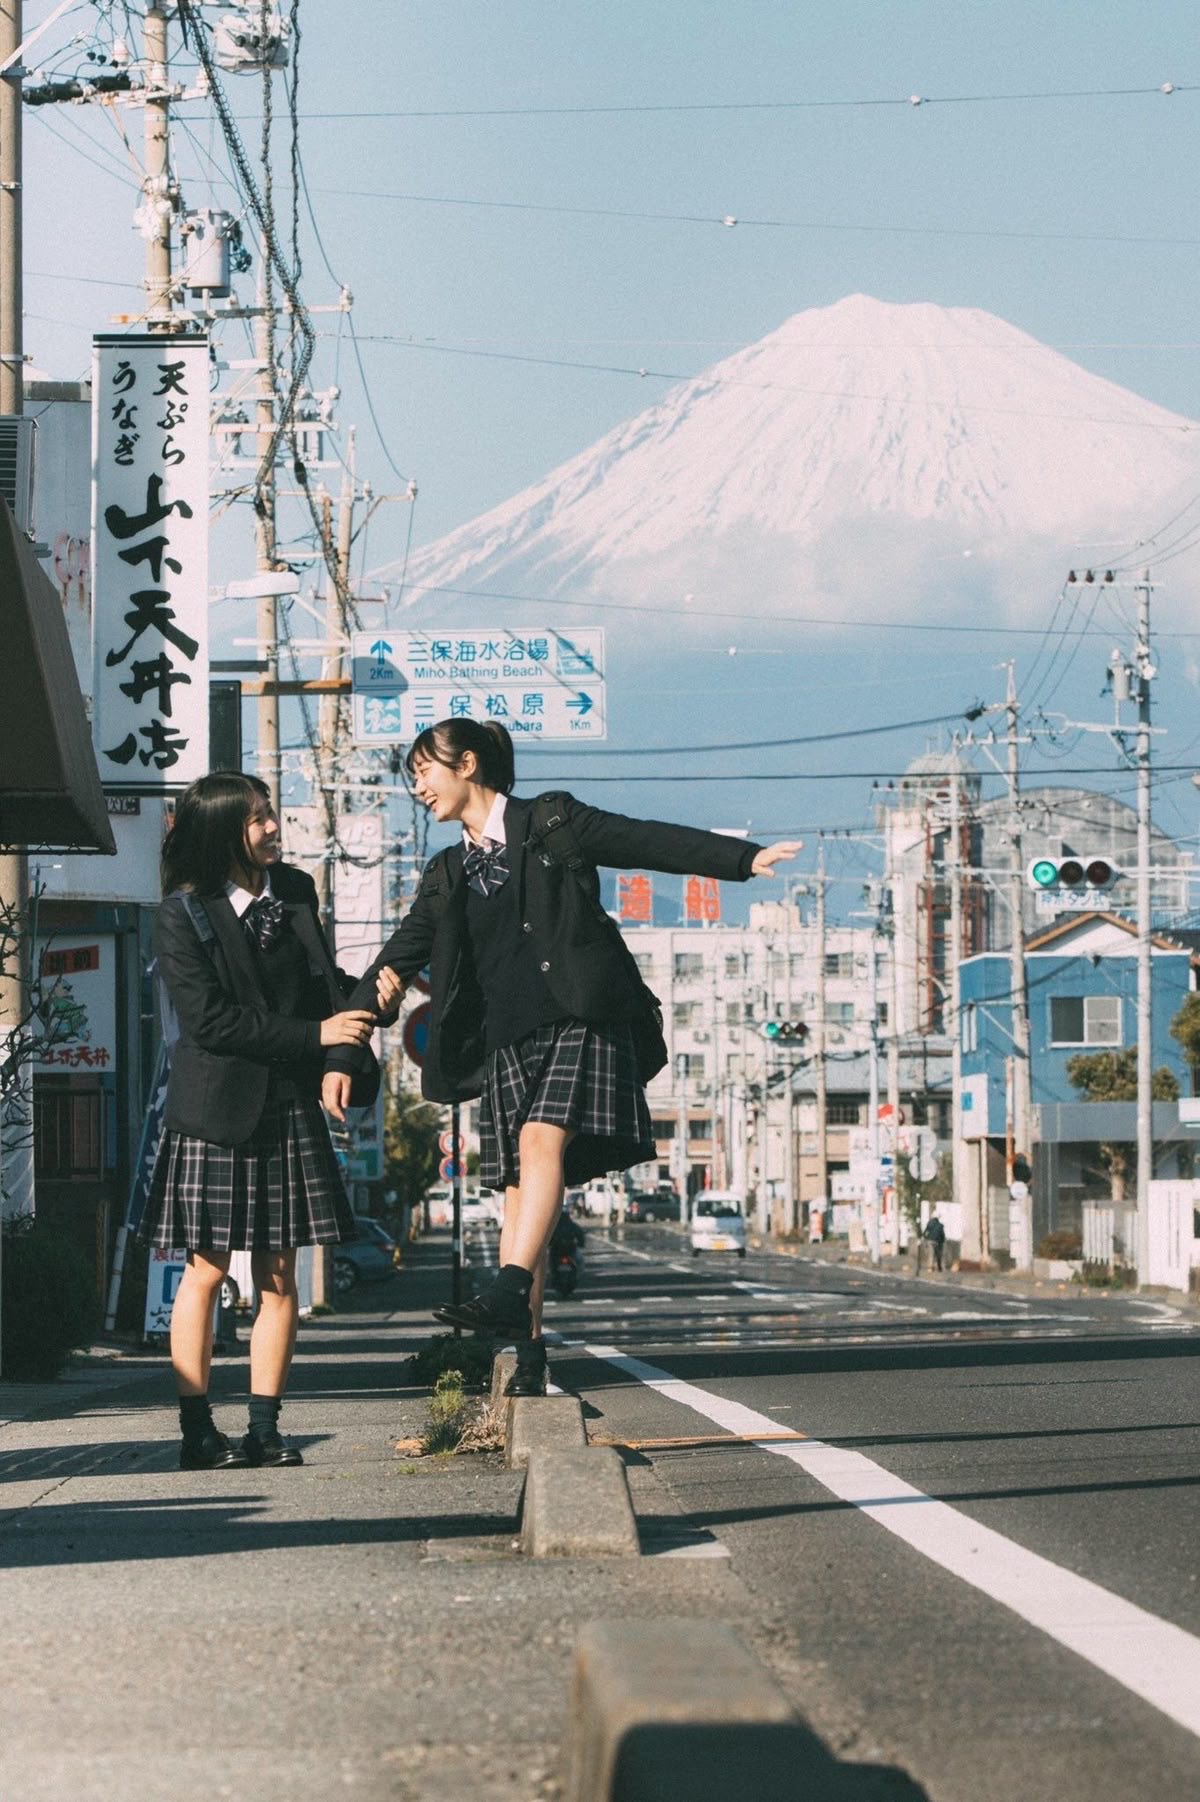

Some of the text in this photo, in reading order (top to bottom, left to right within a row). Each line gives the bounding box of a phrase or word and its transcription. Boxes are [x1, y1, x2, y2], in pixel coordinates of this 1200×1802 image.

[111, 361, 141, 466] うなぎ
[152, 360, 189, 467] 天ぷら
[407, 638, 549, 662] 三保海水浴場
[369, 667, 394, 680] 2Km
[414, 664, 543, 679] Miho Bathing Beach
[413, 693, 545, 717] 三保松原
[570, 719, 592, 730] 1Km
